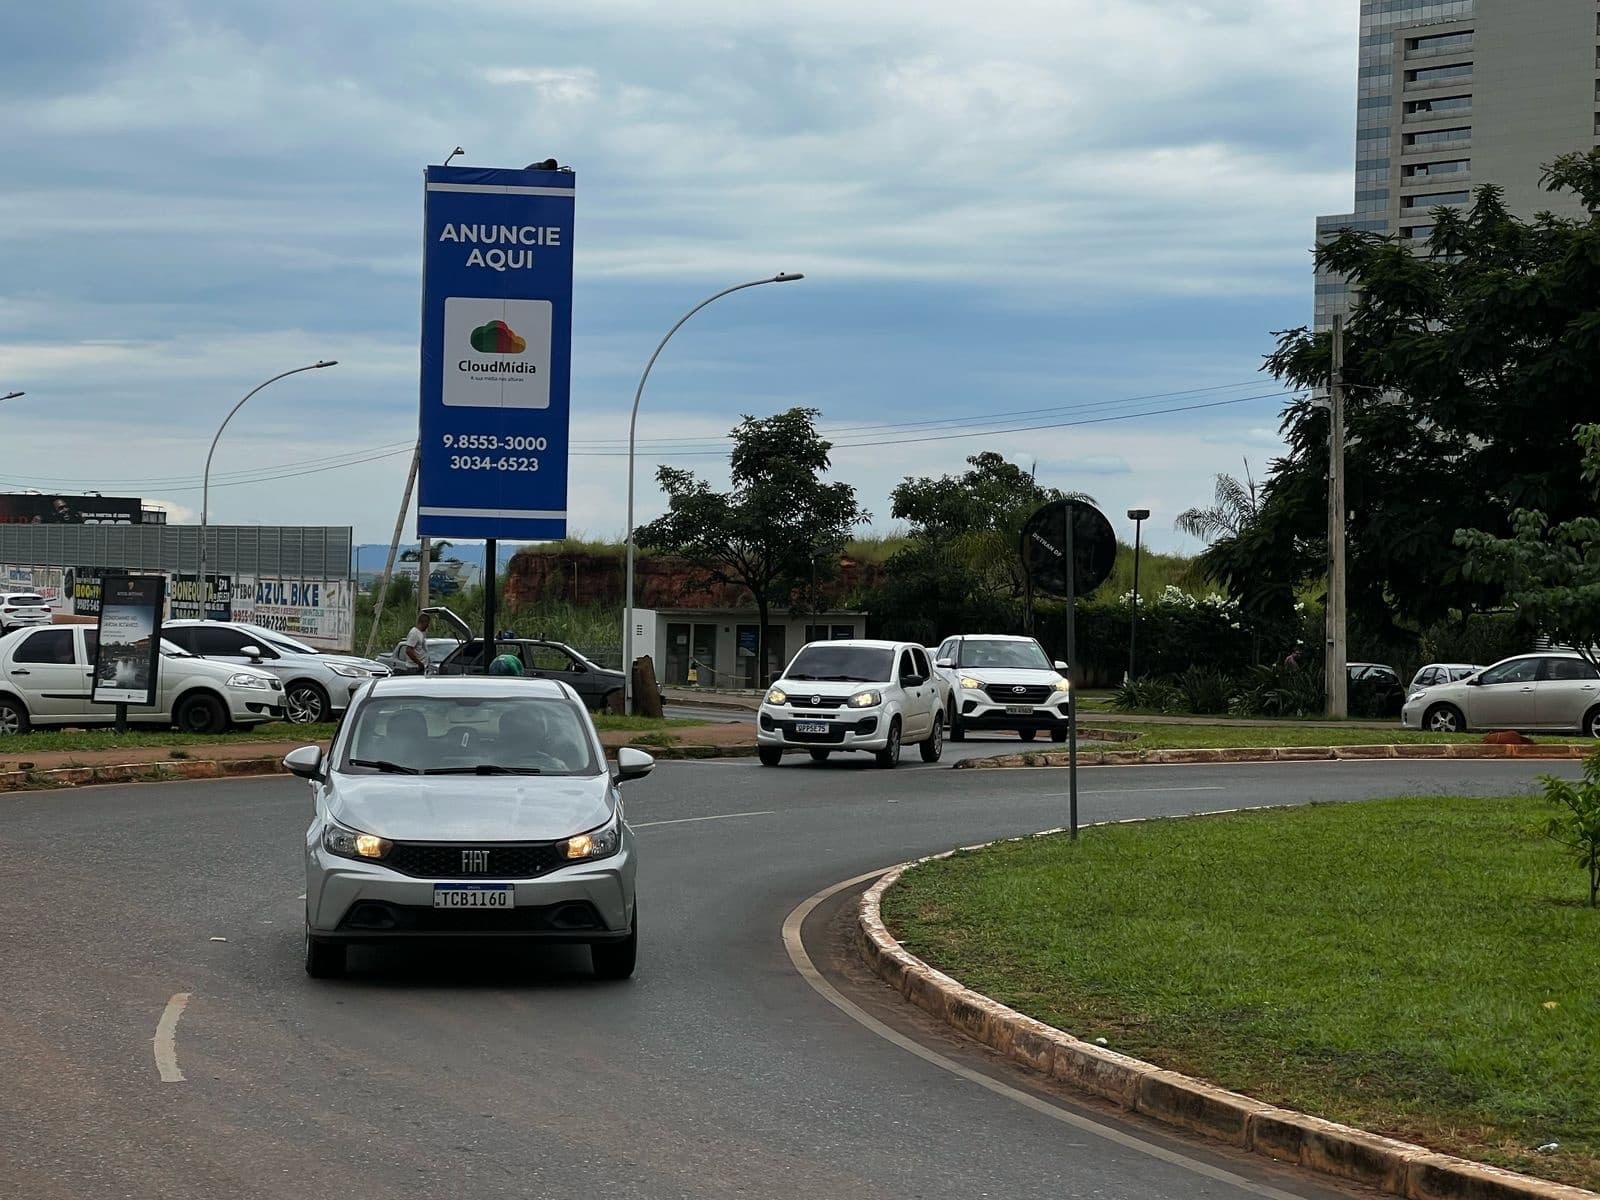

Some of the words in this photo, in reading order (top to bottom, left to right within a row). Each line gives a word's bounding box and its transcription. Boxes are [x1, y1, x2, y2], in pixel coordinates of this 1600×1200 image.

[439, 223, 561, 246] ANUNCIE
[465, 248, 533, 272] AQUI
[458, 360, 536, 374] CloudMídia
[443, 434, 547, 451] 9.8553-3000
[450, 455, 539, 471] 3034-6523
[171, 580, 214, 602] BONEQUTA
[256, 582, 288, 605] AZUL
[290, 583, 319, 607] BIKE
[462, 850, 490, 872] FIAT
